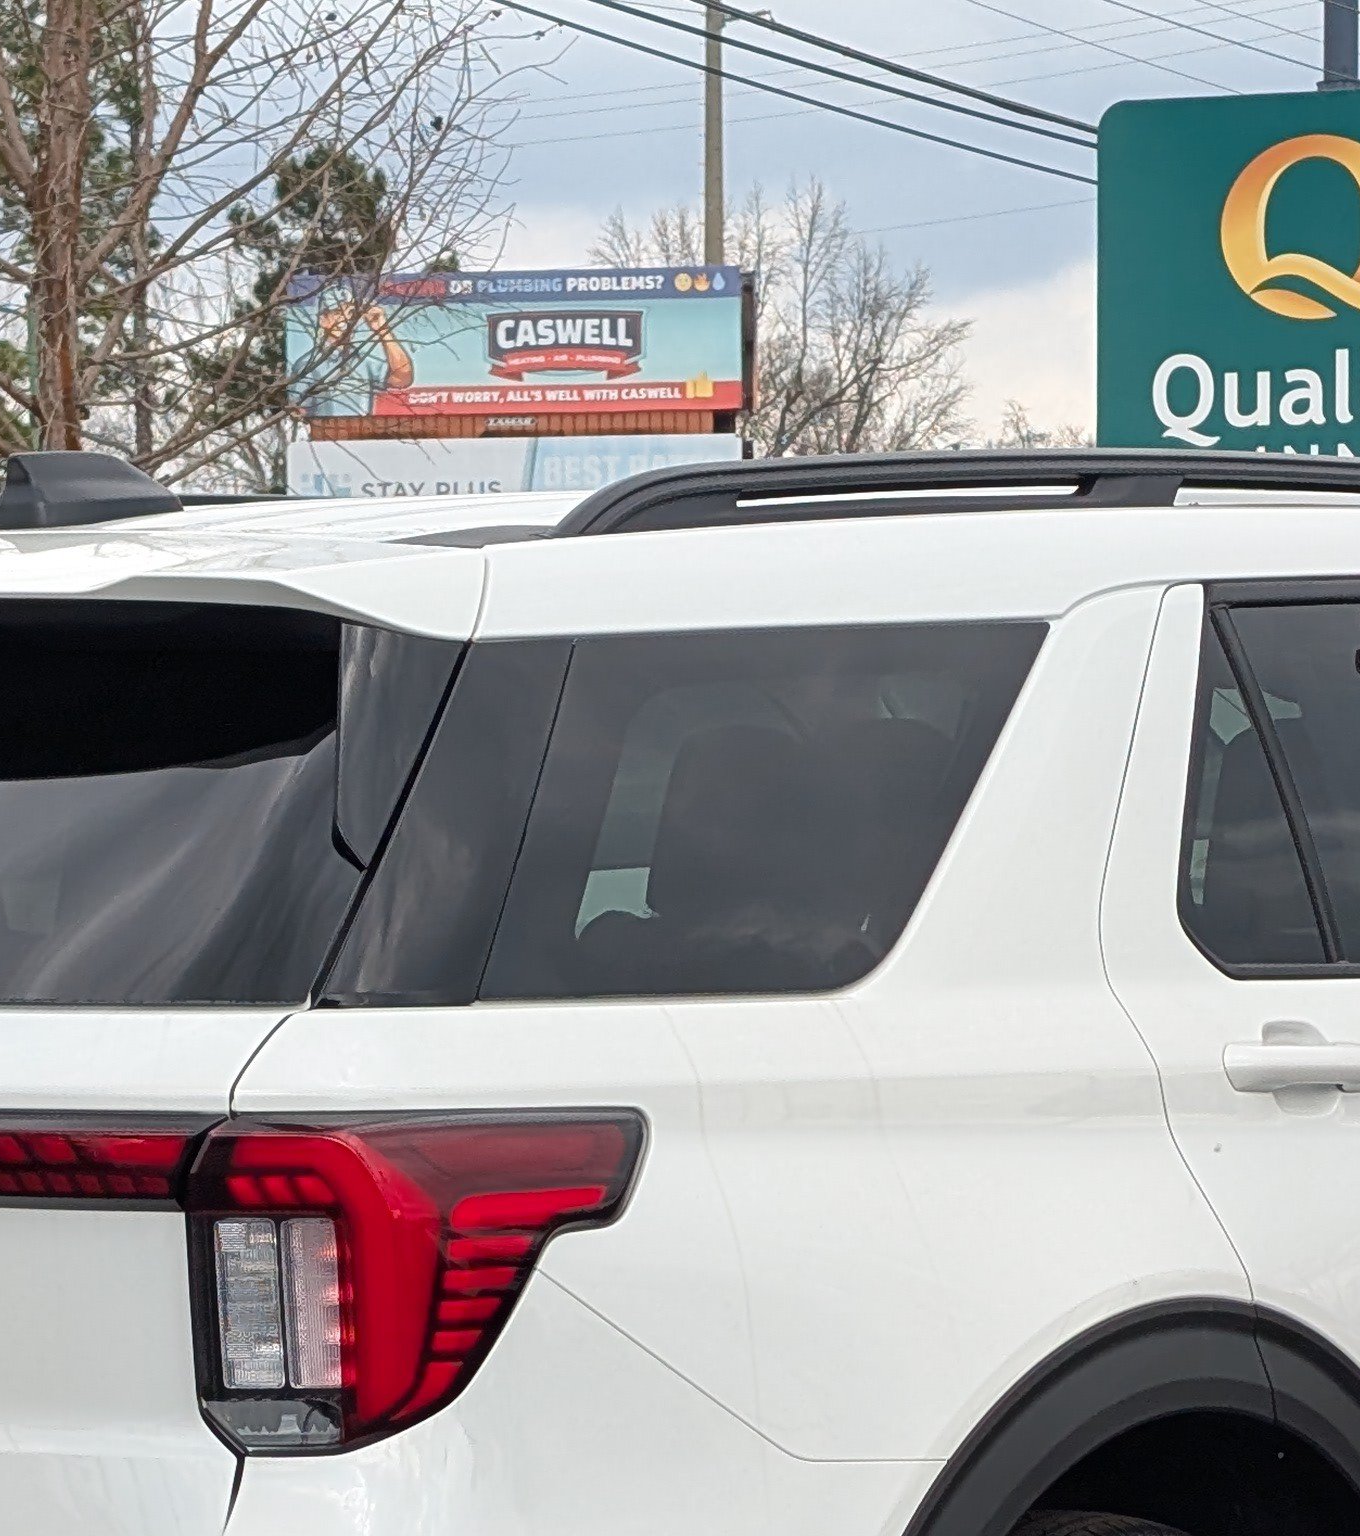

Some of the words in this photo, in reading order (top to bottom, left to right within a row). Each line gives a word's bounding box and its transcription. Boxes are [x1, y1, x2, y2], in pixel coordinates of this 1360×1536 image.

[565, 275, 665, 292] PROBLEMS?
[496, 317, 634, 350] CASWELL
[452, 390, 504, 405] WORRY,
[506, 389, 543, 402] ALL'S
[545, 388, 581, 401] WELL
[583, 387, 619, 401] WITH
[620, 386, 682, 400] CASWELL
